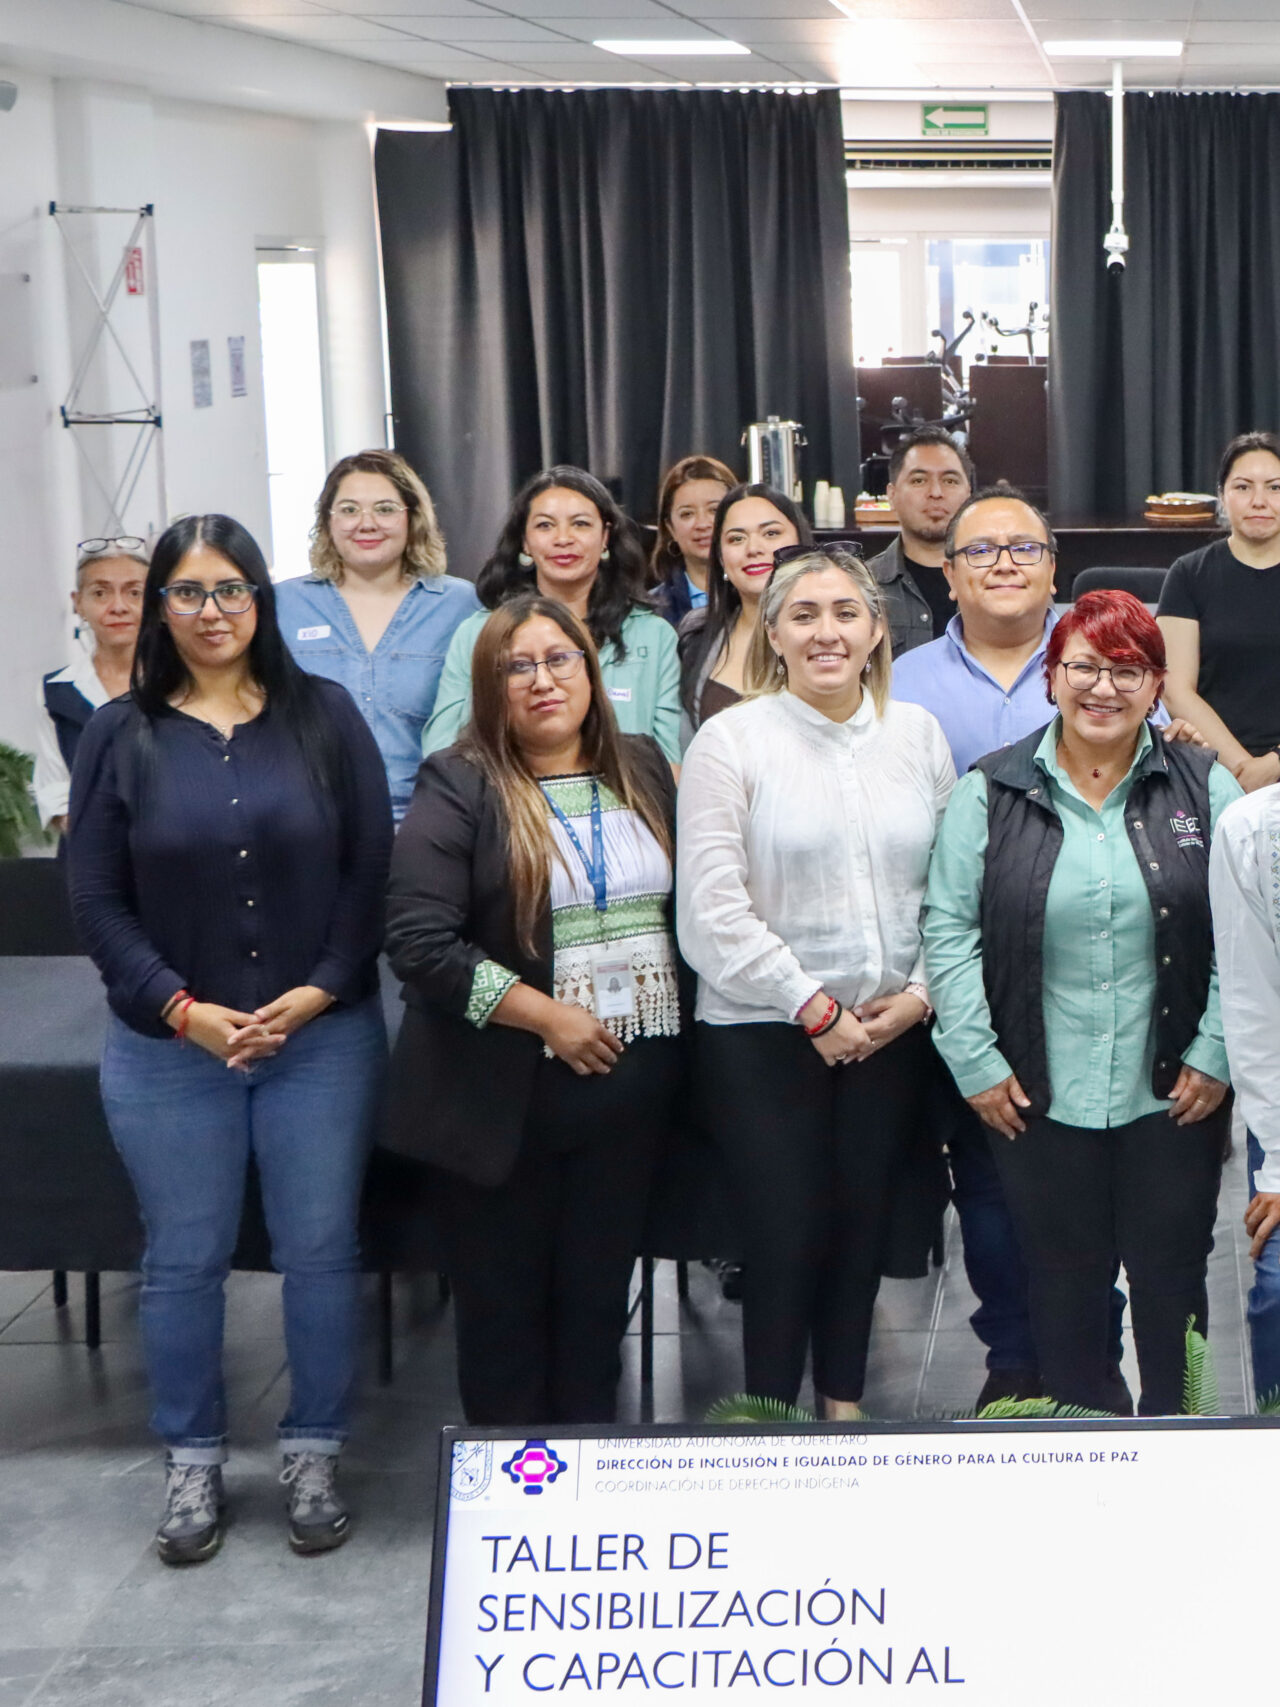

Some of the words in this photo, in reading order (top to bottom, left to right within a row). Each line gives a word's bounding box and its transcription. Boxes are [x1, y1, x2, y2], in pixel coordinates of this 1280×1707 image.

[597, 1438, 682, 1449] UNIVERSIDAD
[771, 1436, 786, 1447] DE
[596, 1455, 673, 1471] DIRECCIÓN
[678, 1458, 695, 1469] DE
[700, 1453, 778, 1470] INCLUSIÓN
[782, 1456, 790, 1468] E
[795, 1455, 868, 1468] IGUALDAD
[872, 1455, 889, 1467] DE
[895, 1451, 952, 1466] GÉNERO
[957, 1453, 996, 1465] PARA
[1000, 1453, 1017, 1465] LA
[1022, 1452, 1084, 1464] CULTURA
[1089, 1451, 1106, 1464] DE
[1111, 1451, 1139, 1464] PAZ
[594, 1477, 704, 1493] COORDINACIÓN
[708, 1479, 724, 1491] DE
[729, 1477, 791, 1491] DERECHO
[794, 1474, 860, 1490] INDÍGENA
[481, 1531, 650, 1575] TALLER
[667, 1529, 731, 1571] DE
[475, 1578, 887, 1633] SENSIBILIZACIÓN
[474, 1653, 506, 1693] Y
[521, 1637, 894, 1692] CAPACITACIÓN
[904, 1644, 966, 1685] AL
